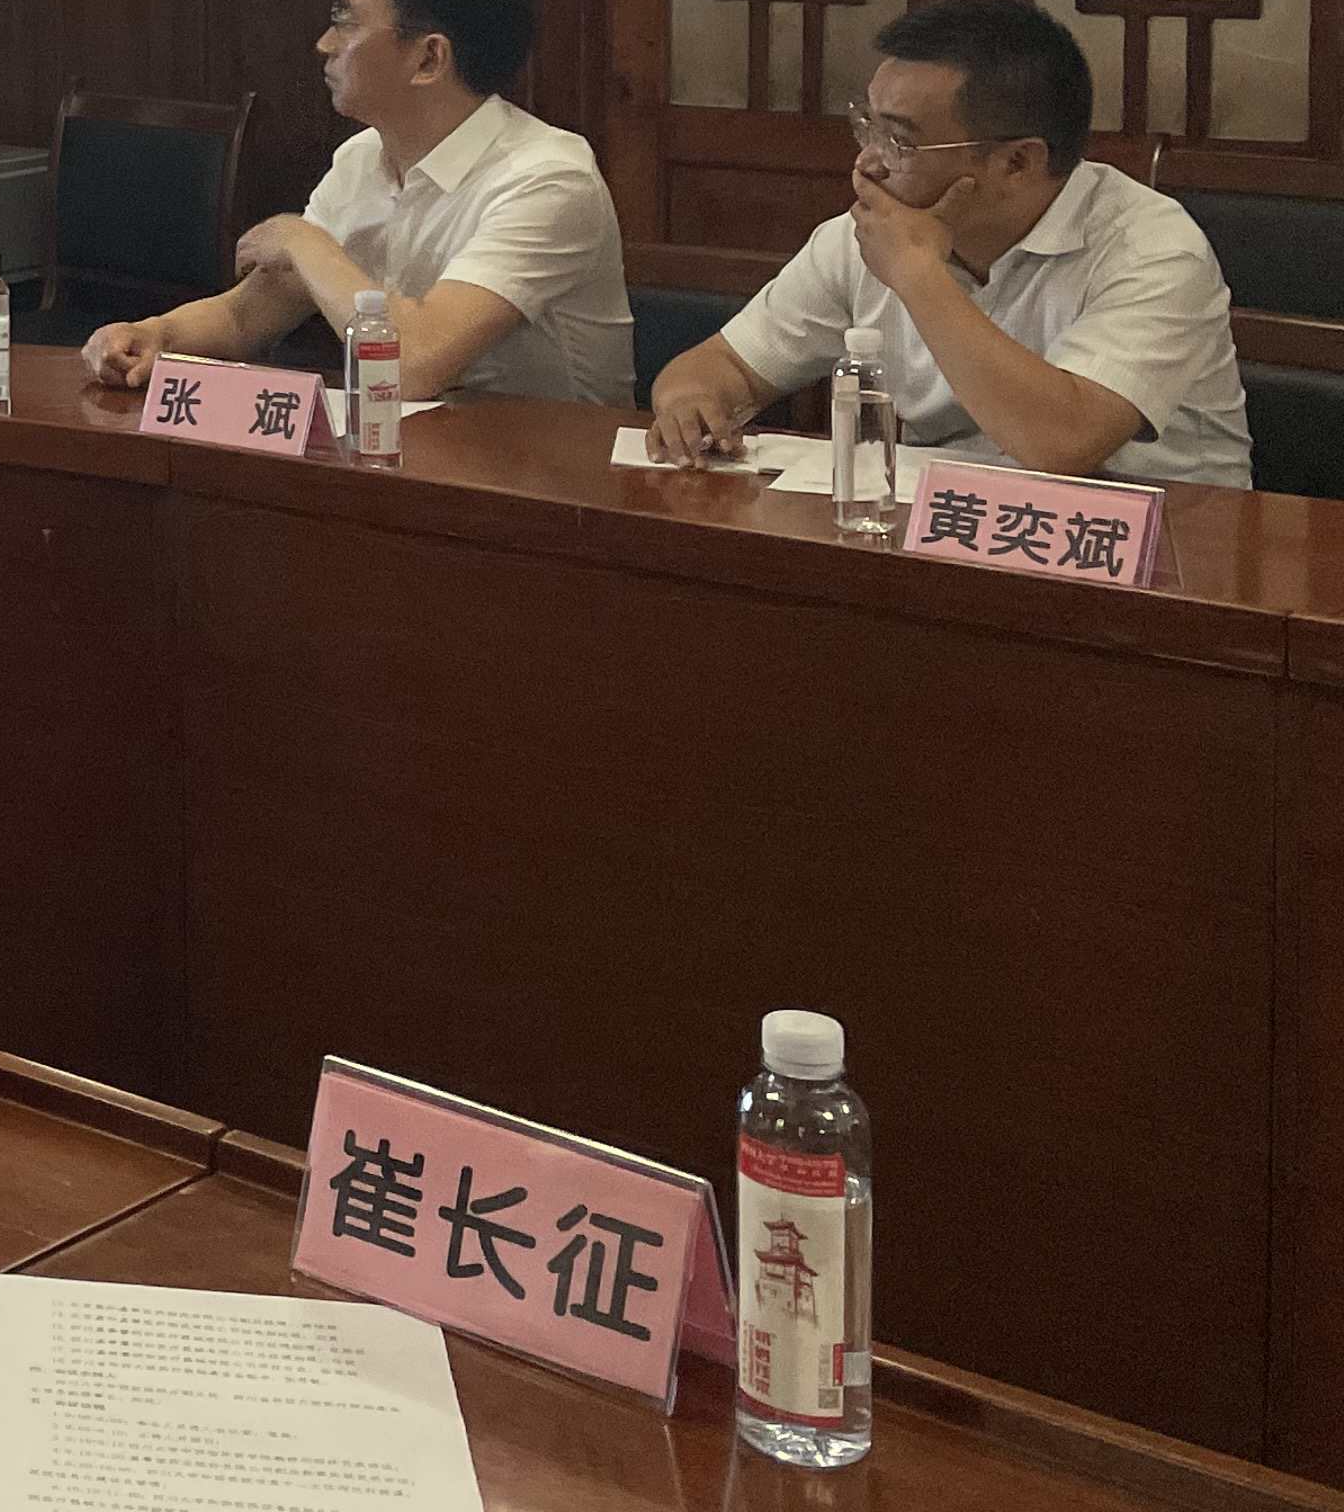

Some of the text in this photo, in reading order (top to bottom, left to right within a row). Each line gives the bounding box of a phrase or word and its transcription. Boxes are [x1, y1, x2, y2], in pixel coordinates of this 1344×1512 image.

[921, 489, 1129, 576] 黄奕斌
[329, 1129, 665, 1342] 崔长征
